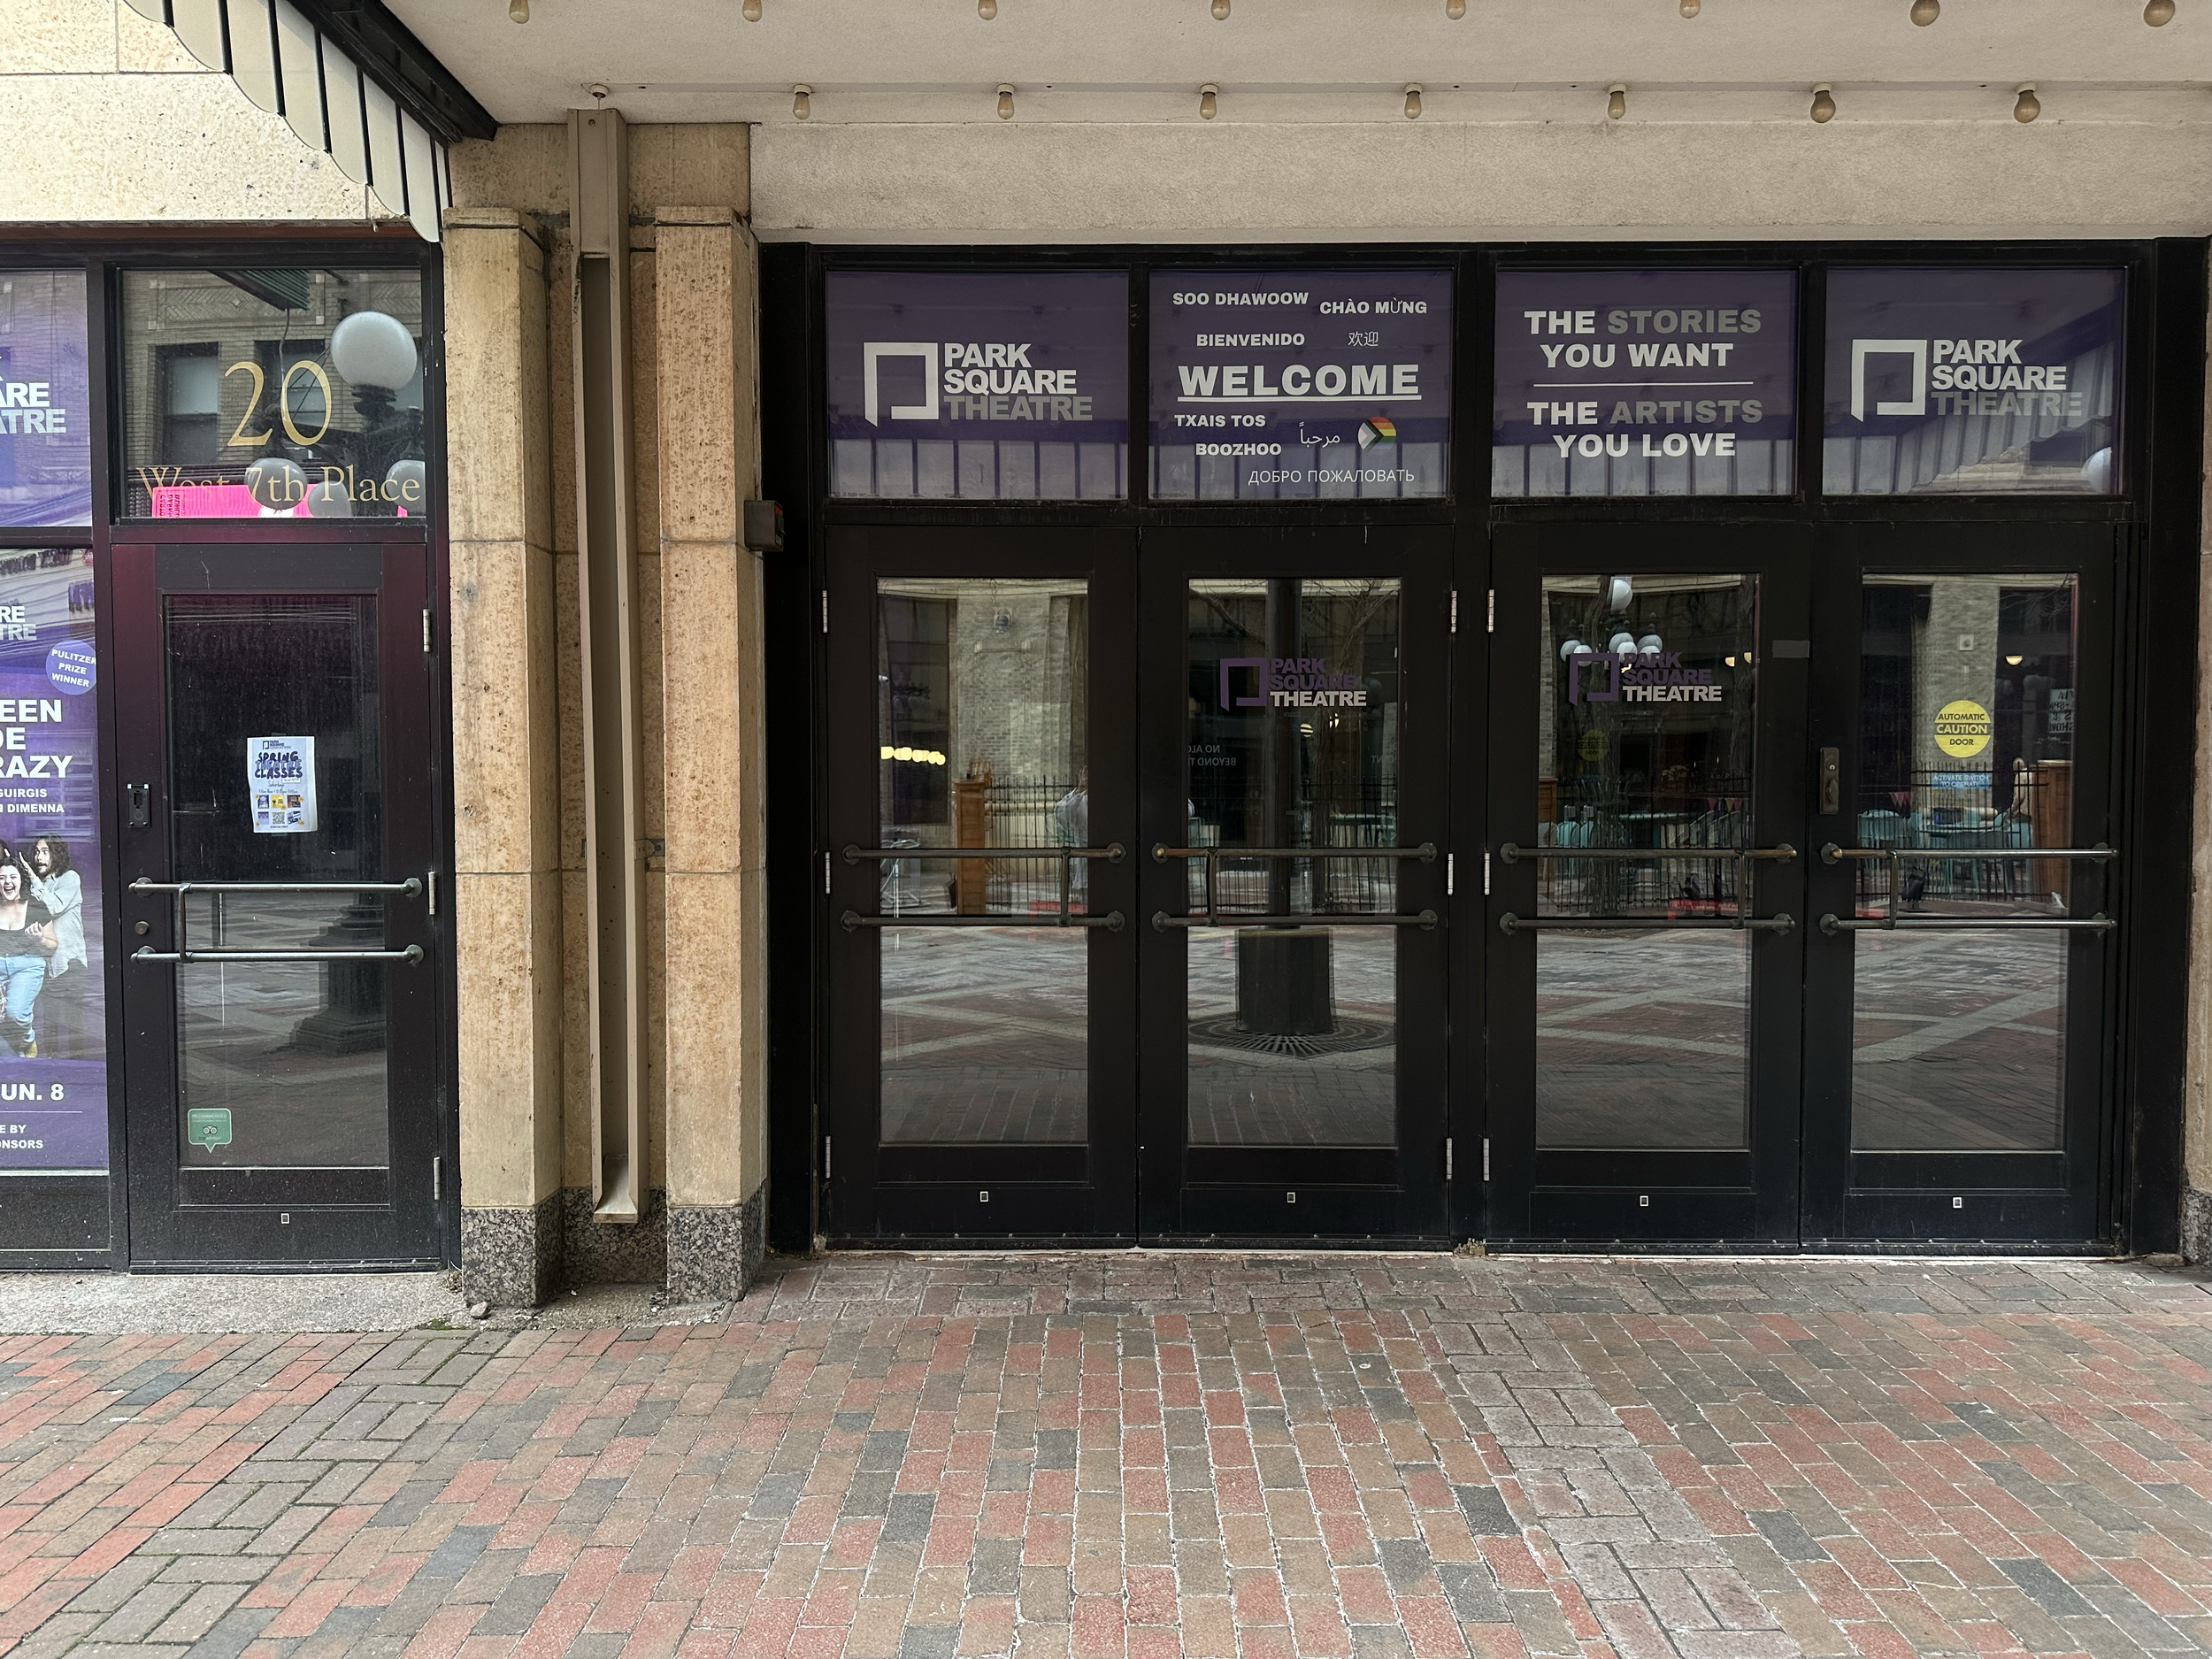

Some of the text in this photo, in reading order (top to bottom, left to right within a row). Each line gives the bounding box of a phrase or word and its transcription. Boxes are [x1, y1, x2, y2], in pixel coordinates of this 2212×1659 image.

[1172, 292, 1309, 305] SOO DHAWOOW
[1319, 297, 1427, 314] CHÀO MỪNG
[1524, 309, 1762, 334] THE STORIES
[1196, 333, 1305, 347] BIENVENIDO
[1348, 331, 1379, 347] 欢迎
[943, 342, 1033, 368] PARK
[1540, 343, 1734, 368] YOU WANT
[1932, 339, 2023, 364] PARK
[943, 369, 1077, 396] SQUARE
[1178, 364, 1419, 396] WELCOME
[1931, 365, 2067, 392] SQUARE
[224, 360, 332, 446] 20
[943, 395, 1093, 421] THEATRE
[1931, 391, 2082, 417] THEATRE
[1174, 414, 1266, 426] TXAIS TOS
[1526, 399, 1763, 426] THE ARTISTS
[1195, 442, 1282, 456] BOOZHOO
[1552, 433, 1736, 457] YOU LOVE
[245, 465, 304, 502] 7th
[320, 465, 421, 503] Place
[1248, 468, 1415, 486] ДОБРО ПОЖАЛОВАТЬ
[51, 649, 96, 665] PULITZER
[1623, 652, 1683, 669] PARK
[58, 662, 88, 675] PRIZE
[1270, 658, 1326, 674] PARK
[51, 672, 90, 687] WINNER
[1269, 674, 1356, 692] SQUARE
[1622, 668, 1712, 686] SQUARE
[1270, 690, 1367, 707] THEATRE
[1622, 685, 1722, 702] THEATRE
[1936, 724, 1988, 734] CAUTION
[0, 727, 27, 750] E
[255, 759, 303, 771] THEATRE
[257, 751, 299, 763] SPRING
[0, 755, 73, 779] AZY
[255, 766, 303, 780] CLASSES
[7, 803, 65, 813] DIMENNA
[1, 1083, 65, 1101] UN. 8
[10, 1125, 27, 1133] BY
[0, 1140, 43, 1149] NSORS
